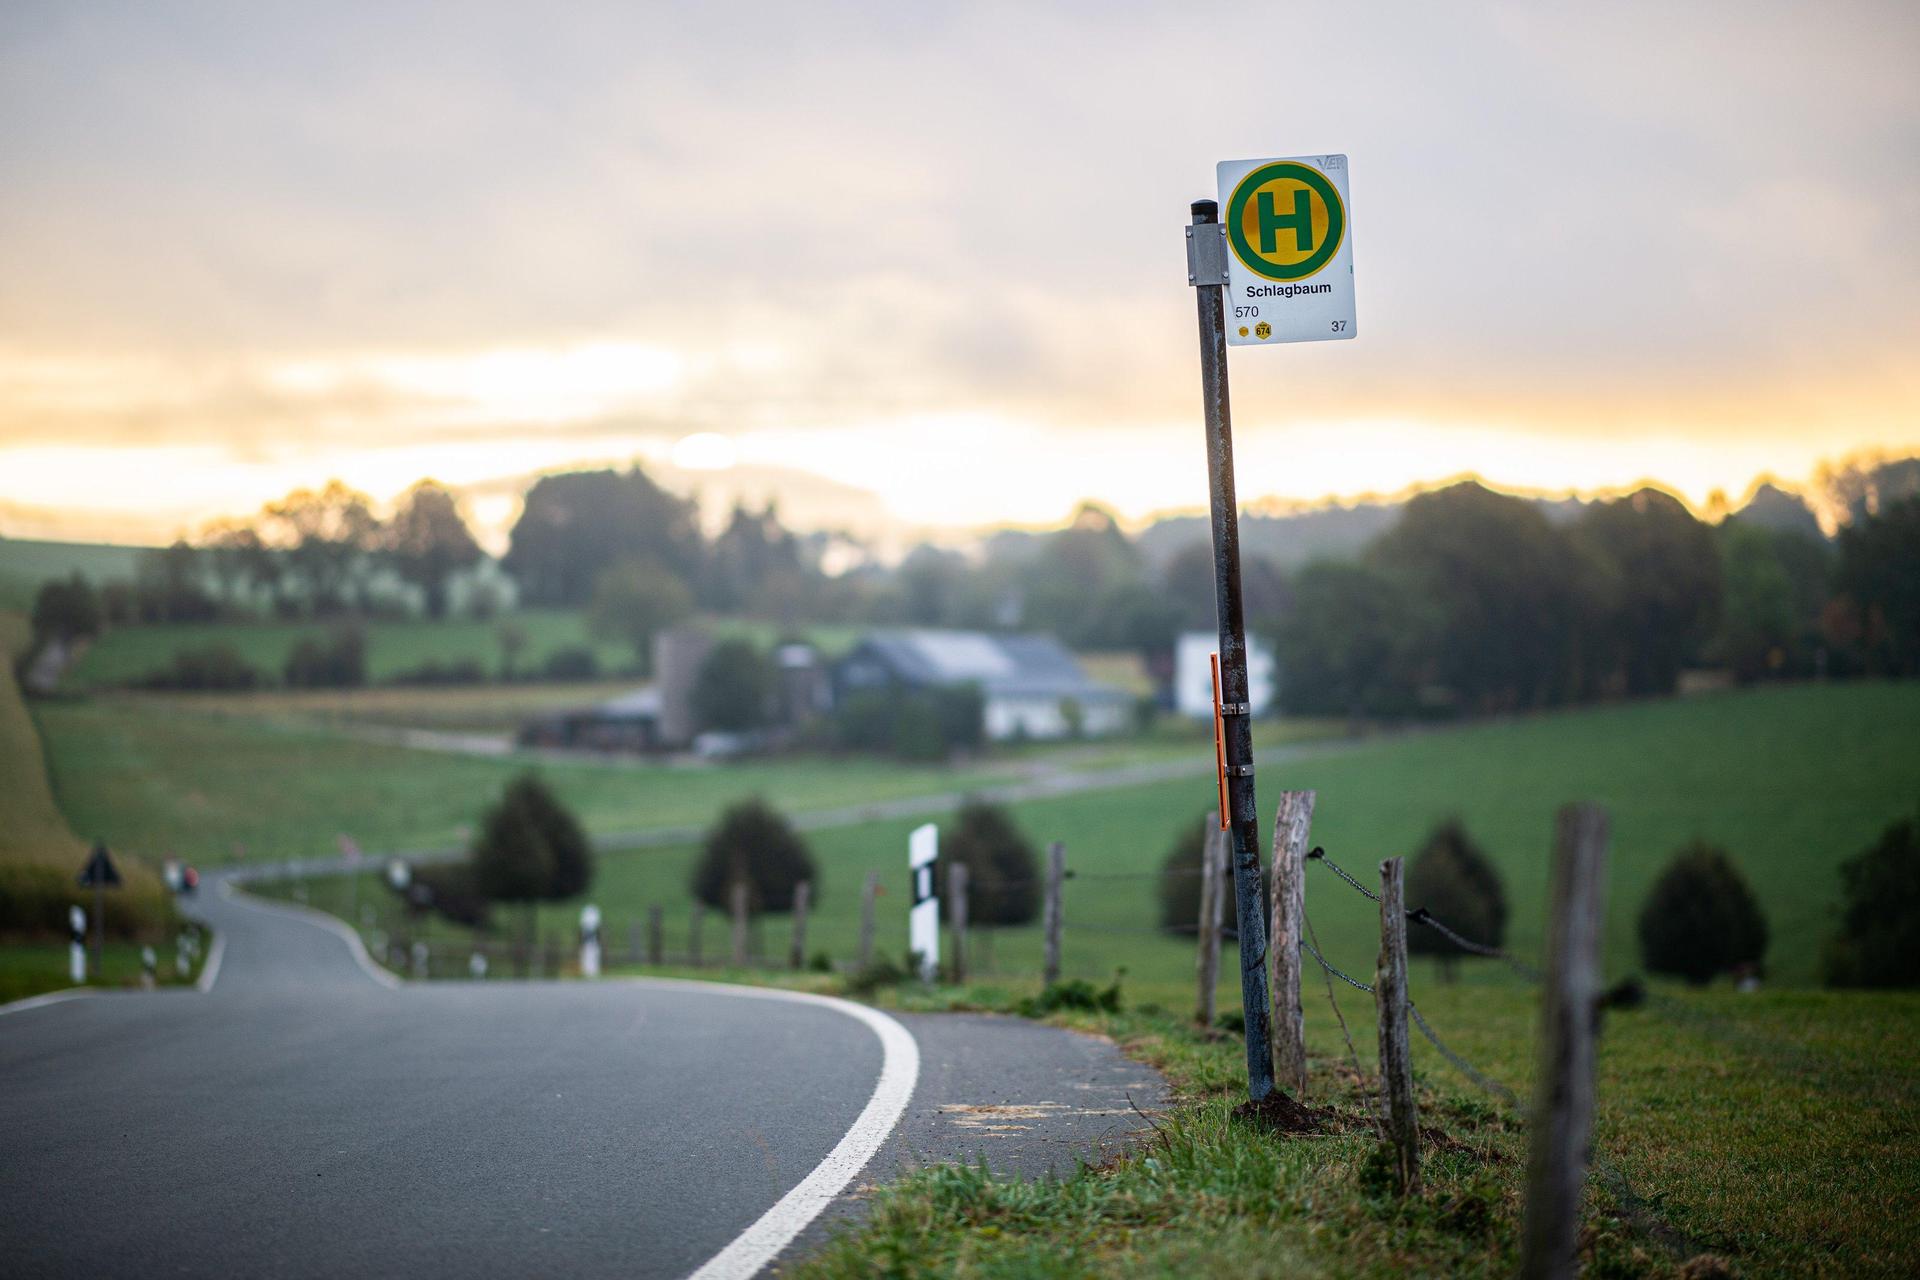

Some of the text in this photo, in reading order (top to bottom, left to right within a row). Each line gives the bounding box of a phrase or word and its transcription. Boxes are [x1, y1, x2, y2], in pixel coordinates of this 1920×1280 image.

[1257, 189, 1314, 254] H
[1246, 284, 1332, 298] Schlagbaum
[1235, 305, 1259, 318] 570
[1256, 327, 1270, 336] 674
[1331, 320, 1347, 332] 37
